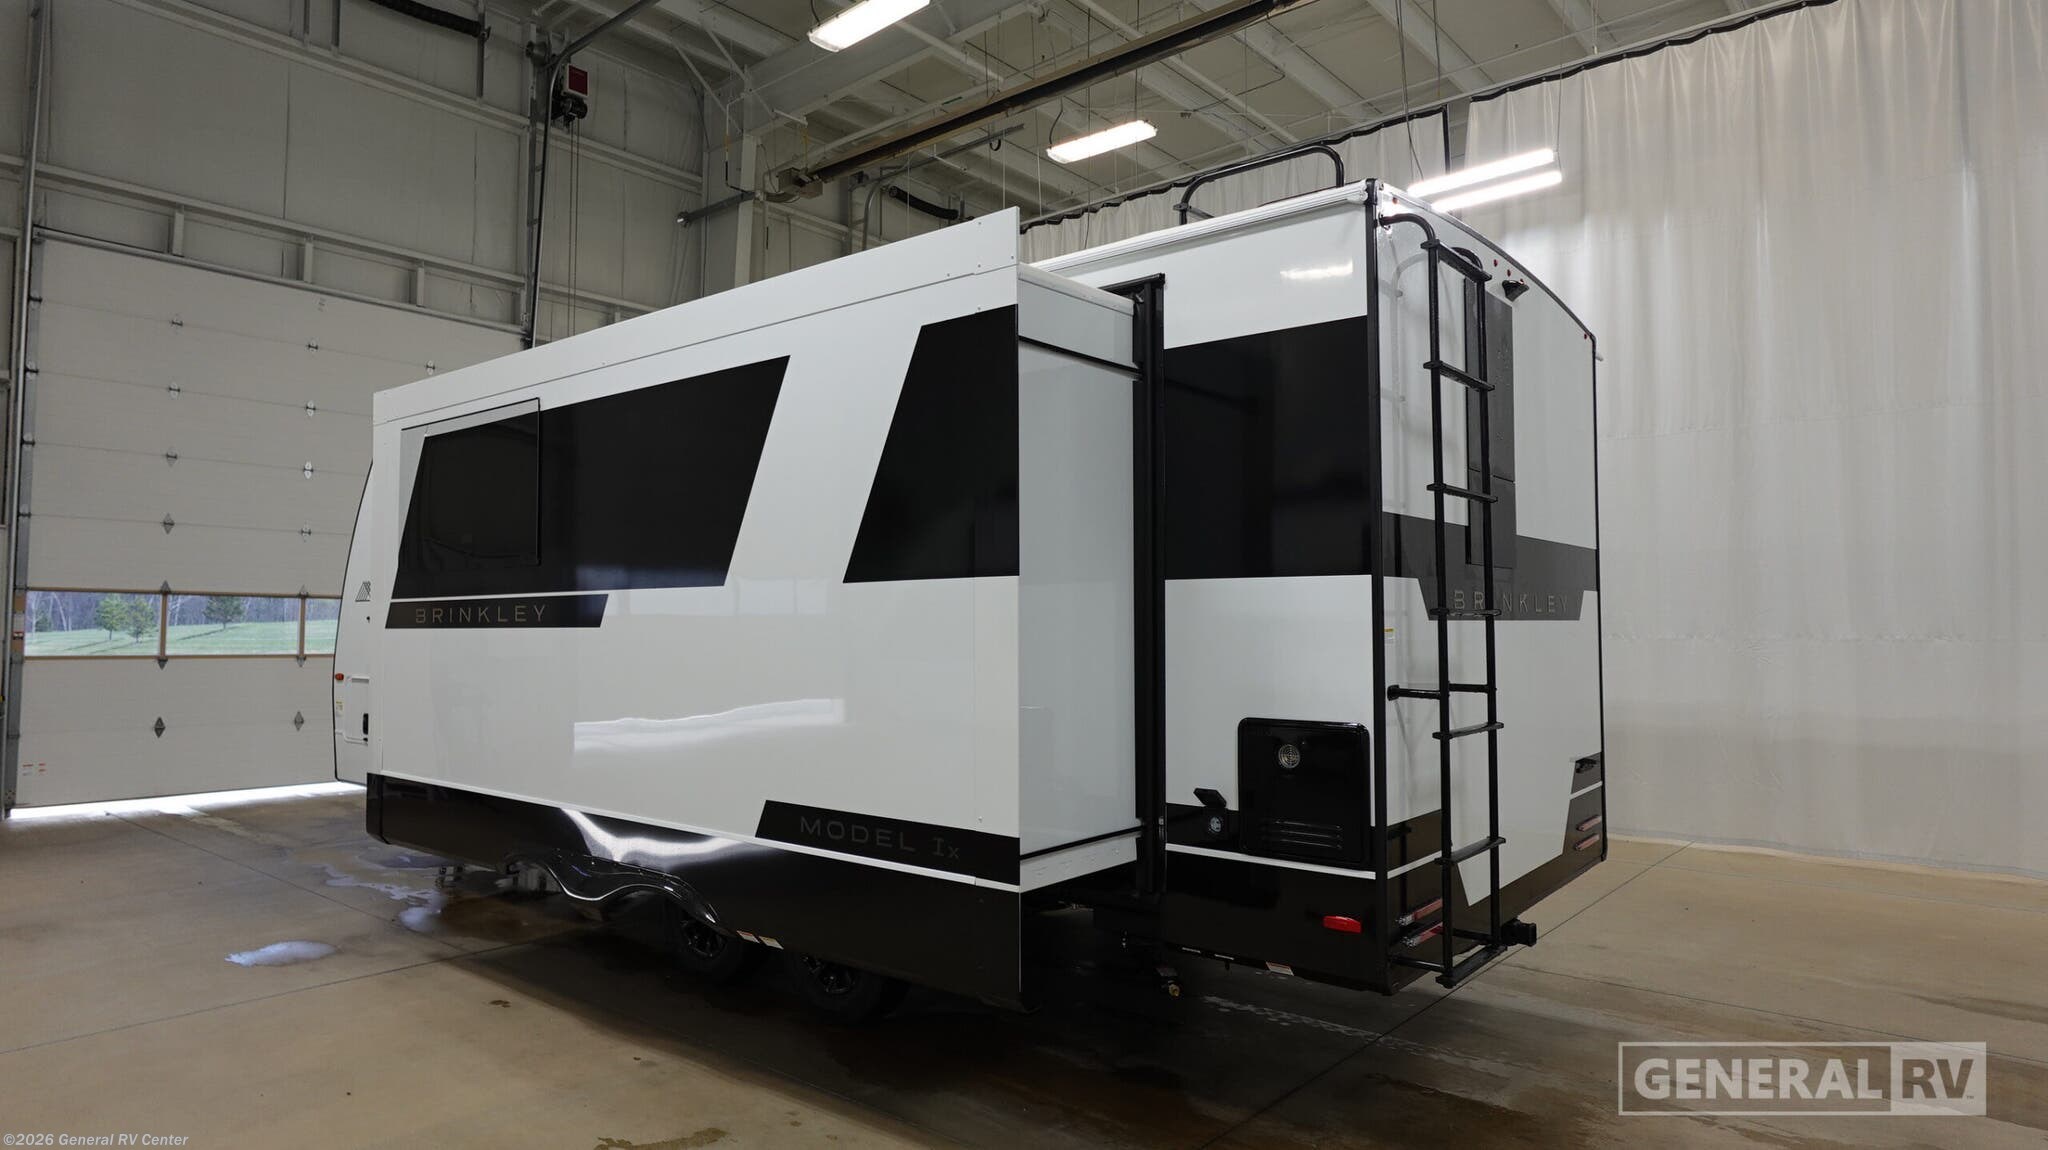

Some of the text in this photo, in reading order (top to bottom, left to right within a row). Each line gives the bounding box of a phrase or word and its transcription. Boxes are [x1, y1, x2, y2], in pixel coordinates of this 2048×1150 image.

[1454, 591, 1567, 613] BRNKLEY
[416, 605, 546, 624] BRINKLEY
[801, 816, 915, 851] MODEL
